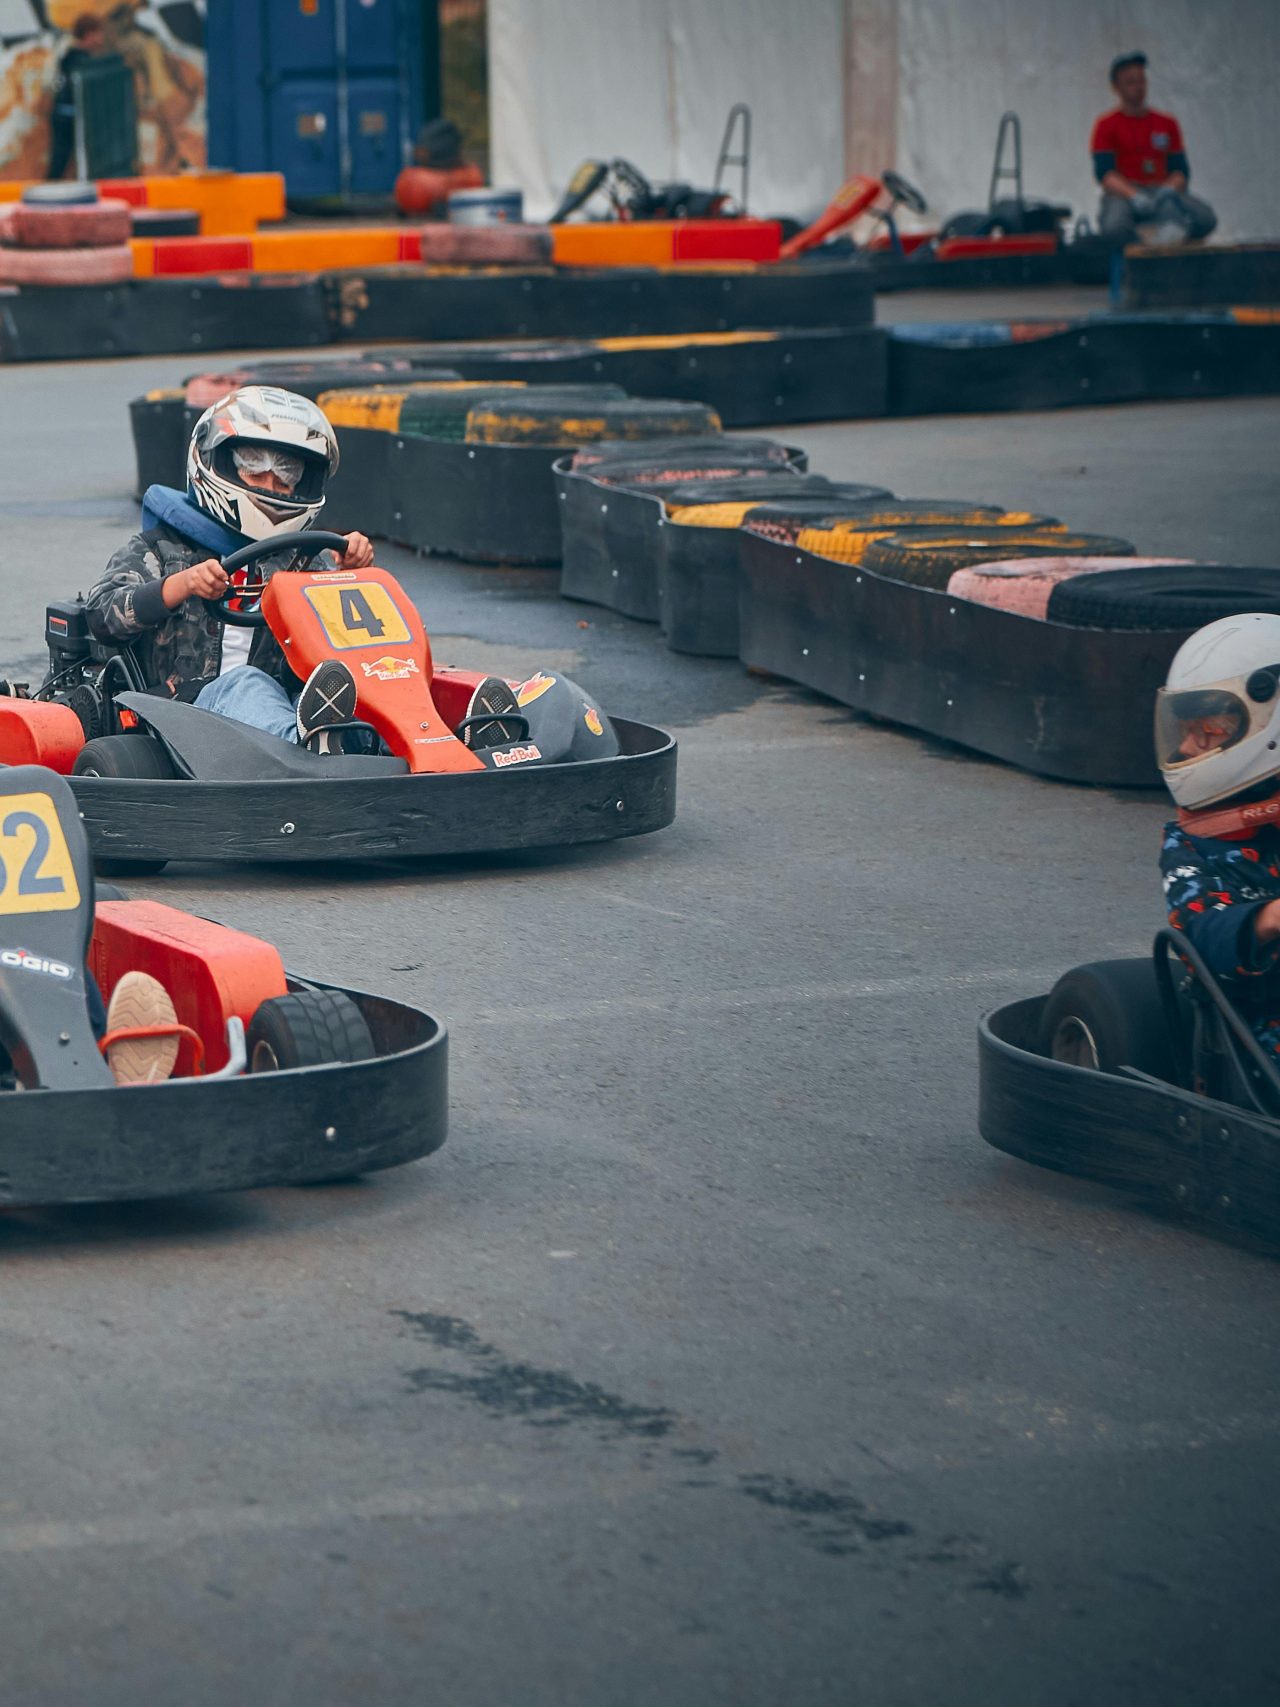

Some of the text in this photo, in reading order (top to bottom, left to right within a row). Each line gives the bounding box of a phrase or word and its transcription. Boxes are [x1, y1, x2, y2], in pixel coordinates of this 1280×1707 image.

[338, 588, 386, 638] 4
[494, 746, 541, 766] Red Bull
